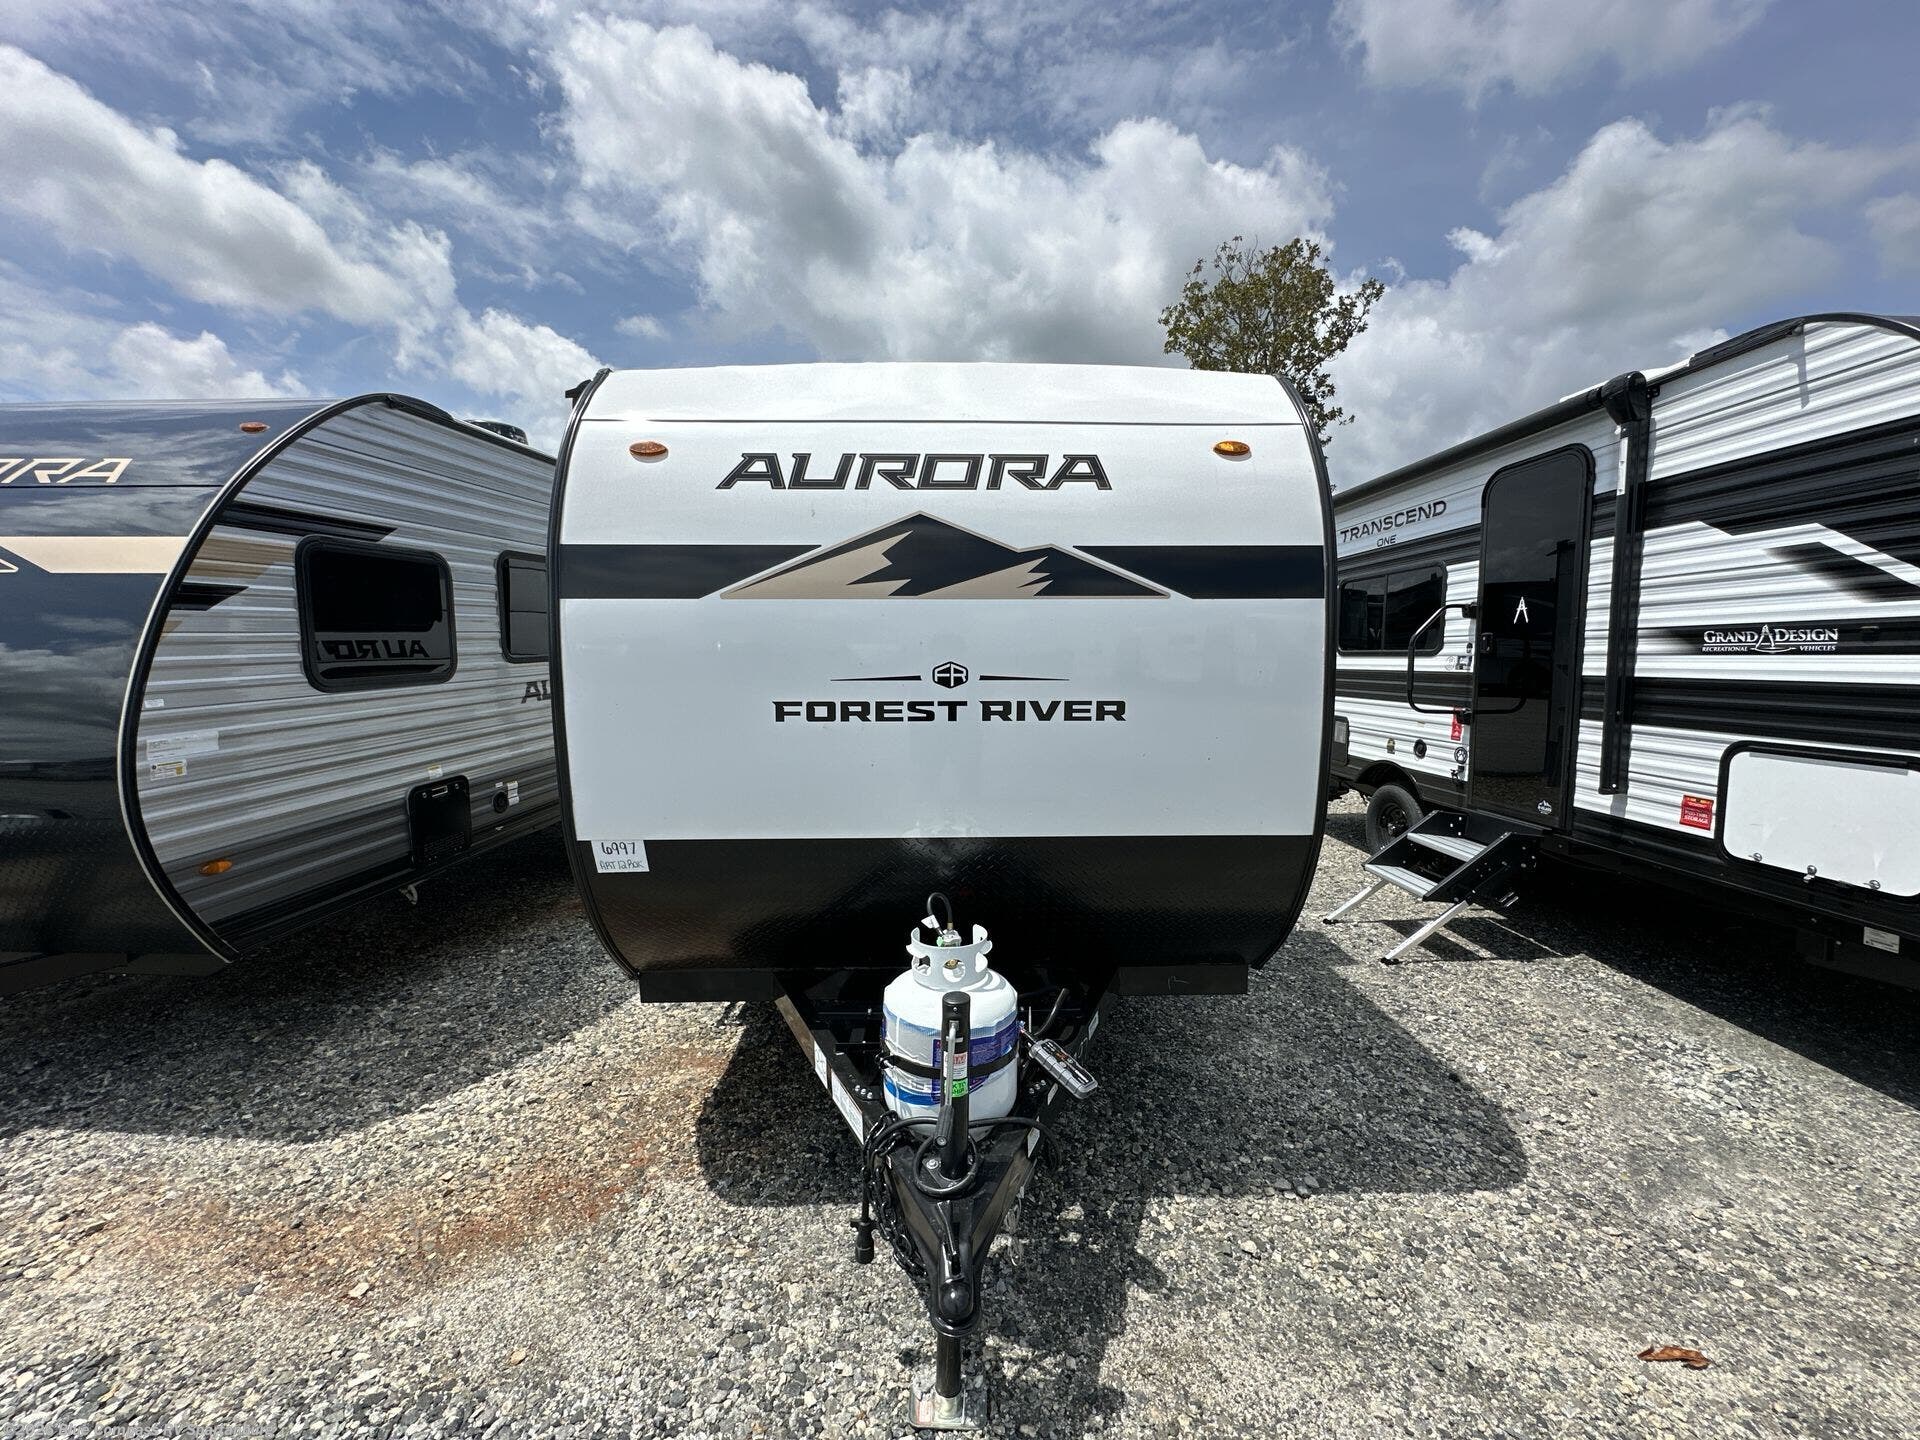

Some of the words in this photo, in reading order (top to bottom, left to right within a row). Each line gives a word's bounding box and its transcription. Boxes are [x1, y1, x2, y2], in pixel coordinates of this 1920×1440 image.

[715, 453, 1112, 490] AURORA
[1340, 500, 1447, 543] TRANSCEND
[1376, 535, 1397, 547] ONE
[1703, 630, 1758, 643] GRAND
[1773, 628, 1838, 642] DESIGN
[772, 700, 968, 722] FOREST
[978, 700, 1127, 722] RIVER
[601, 841, 635, 855] 6997
